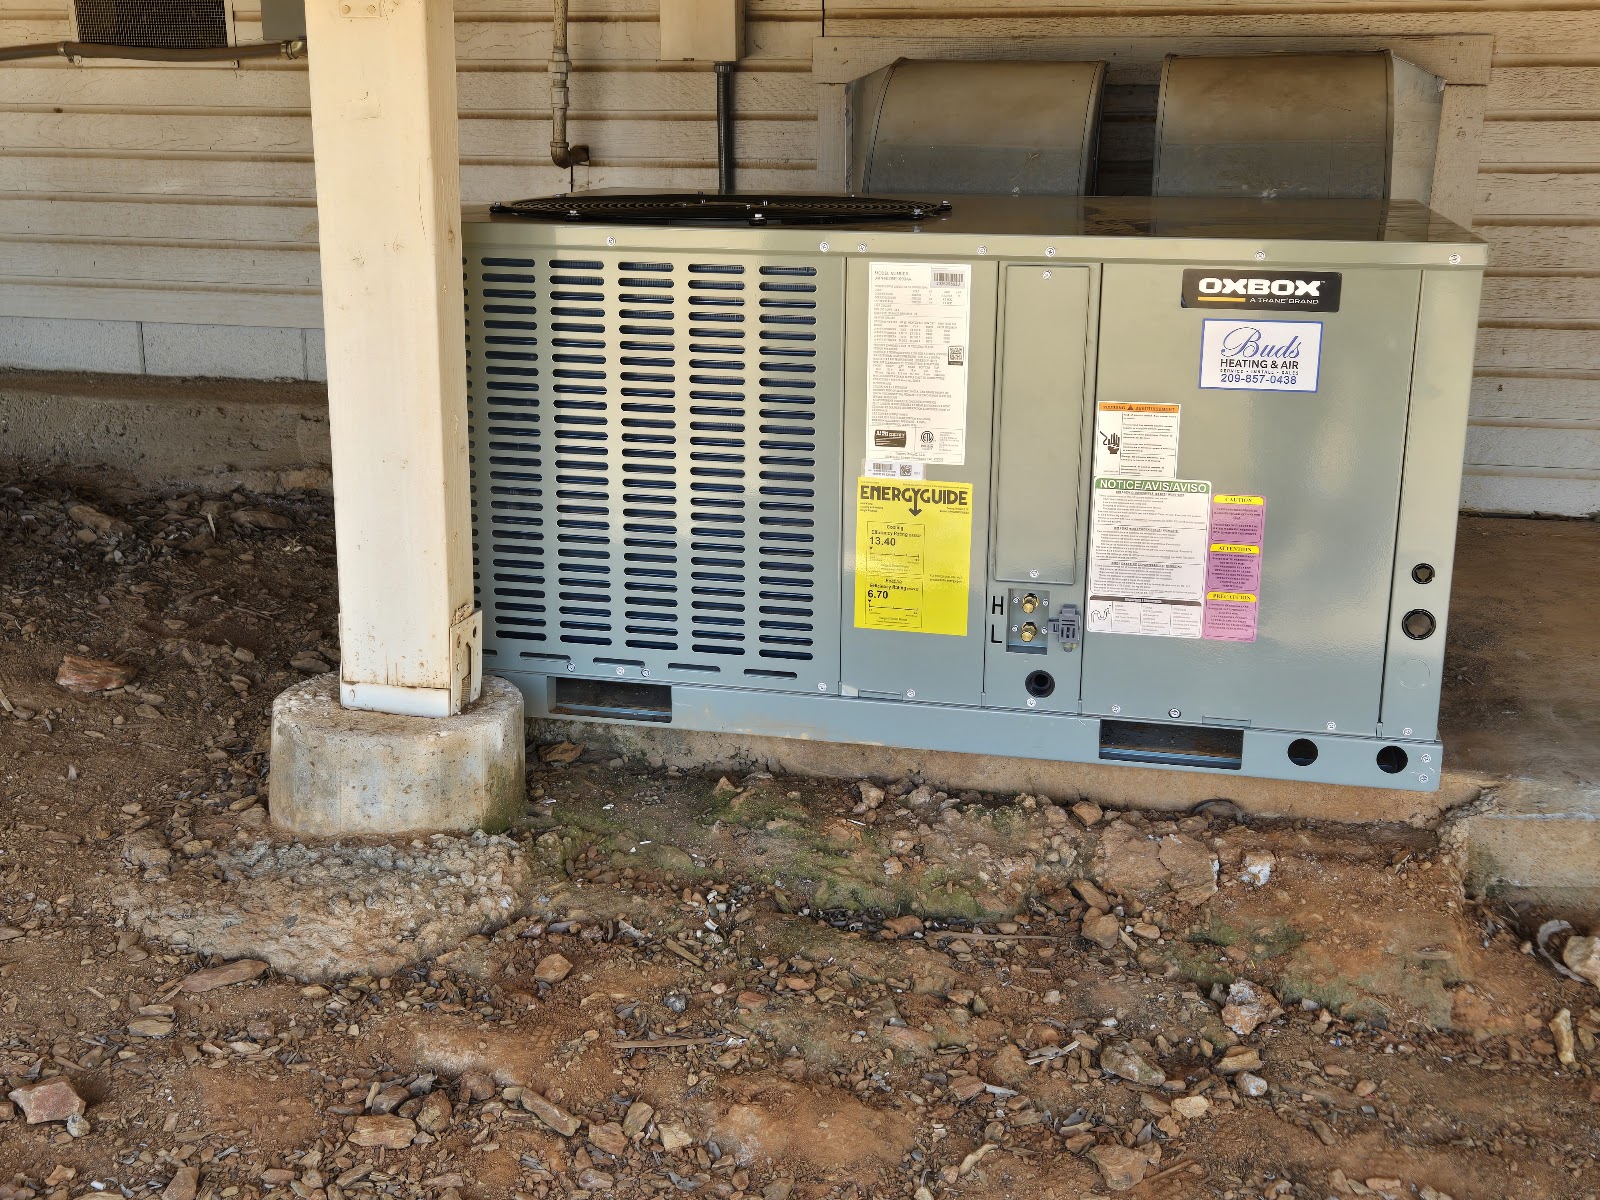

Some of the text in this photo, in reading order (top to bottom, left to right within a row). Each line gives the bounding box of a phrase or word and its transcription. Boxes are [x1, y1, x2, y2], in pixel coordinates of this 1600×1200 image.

[1198, 277, 1321, 297] OXBOX
[1220, 326, 1302, 359] Buds
[1220, 358, 1299, 370] HEATING & AIR
[1220, 373, 1297, 385] 209-857-0438
[1100, 479, 1207, 493] NOTICE/AVIS/AVISO
[860, 484, 968, 506] ENERGYGUIDE
[869, 536, 896, 547] 13.40
[867, 589, 889, 600] 6.70
[991, 595, 1004, 616] H
[990, 624, 1003, 644] L
